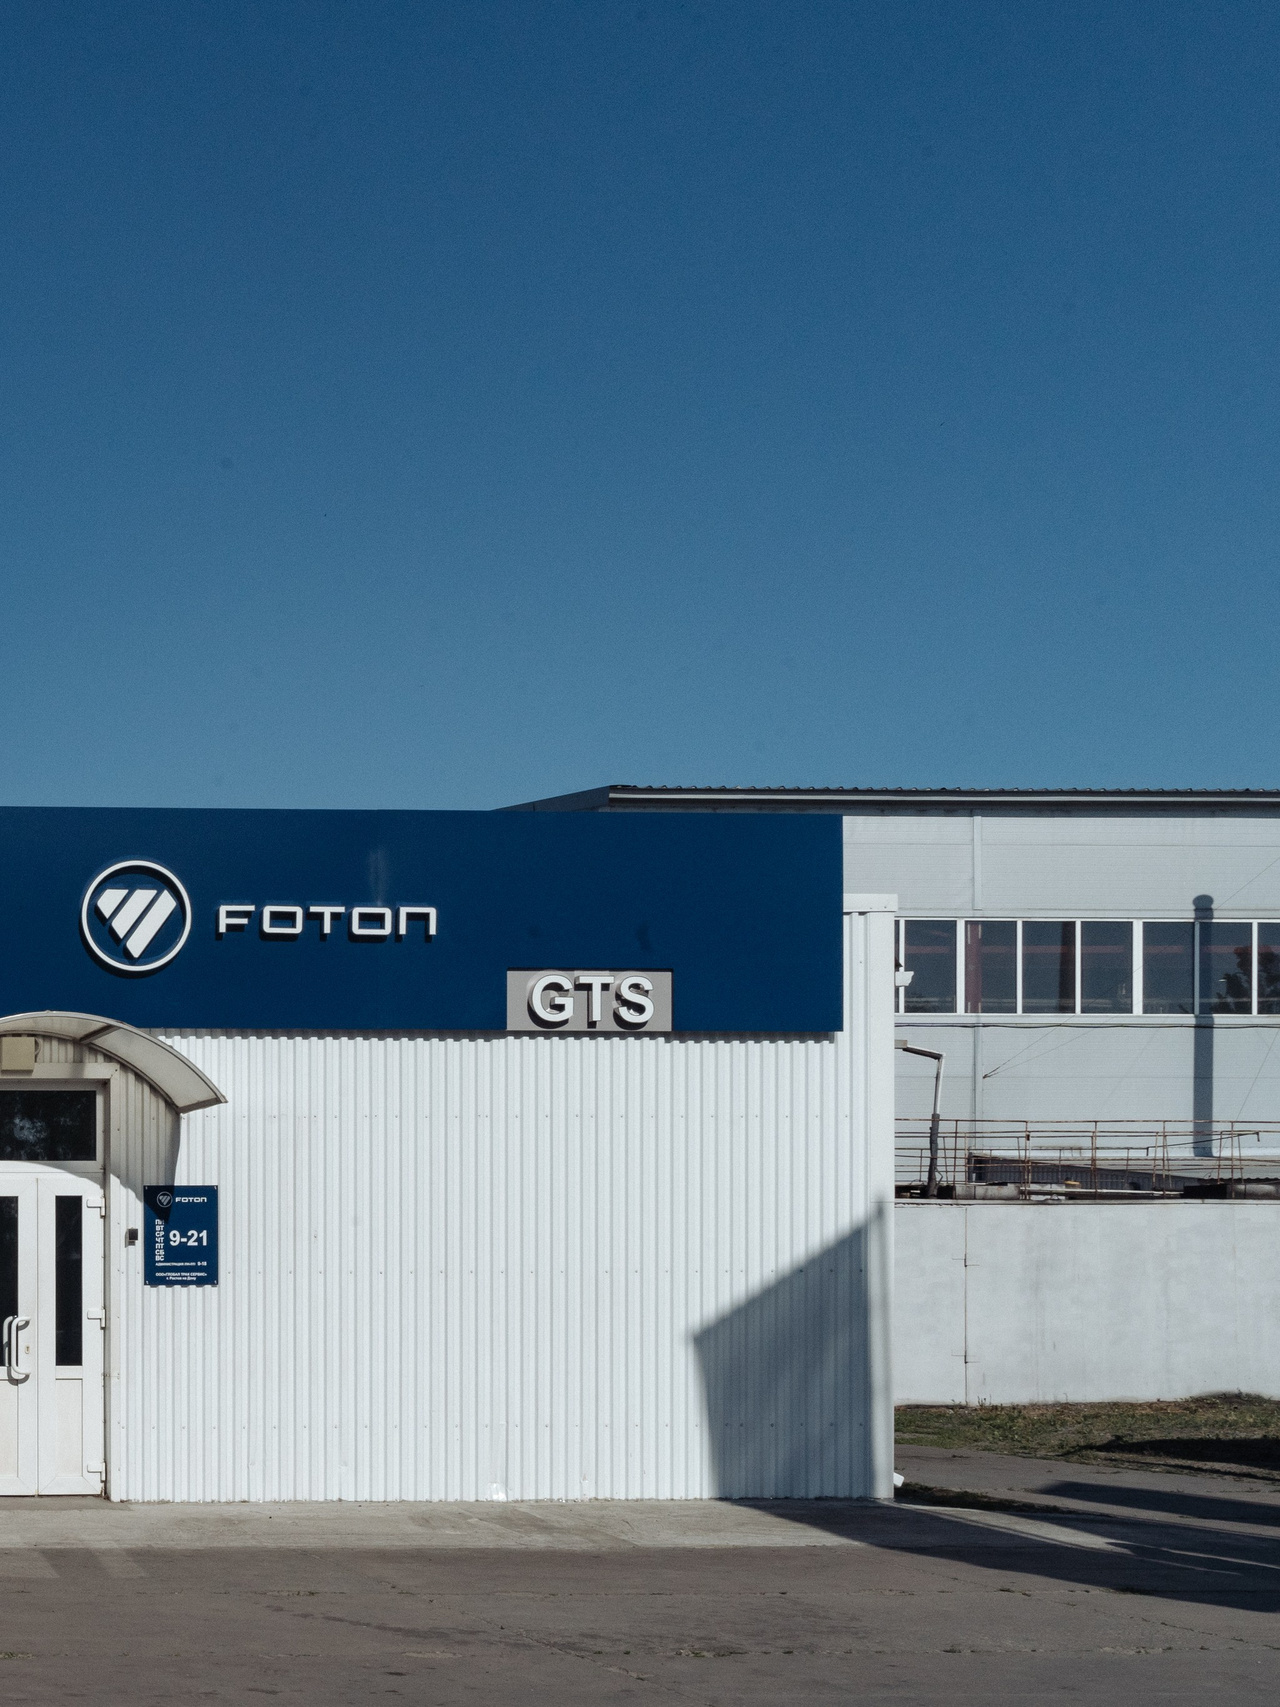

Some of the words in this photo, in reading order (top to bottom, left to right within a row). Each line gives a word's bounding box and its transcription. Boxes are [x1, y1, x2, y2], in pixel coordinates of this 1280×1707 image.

[219, 904, 437, 936] FOTON
[531, 975, 655, 1024] GTS
[169, 1230, 208, 1246] 9-21
